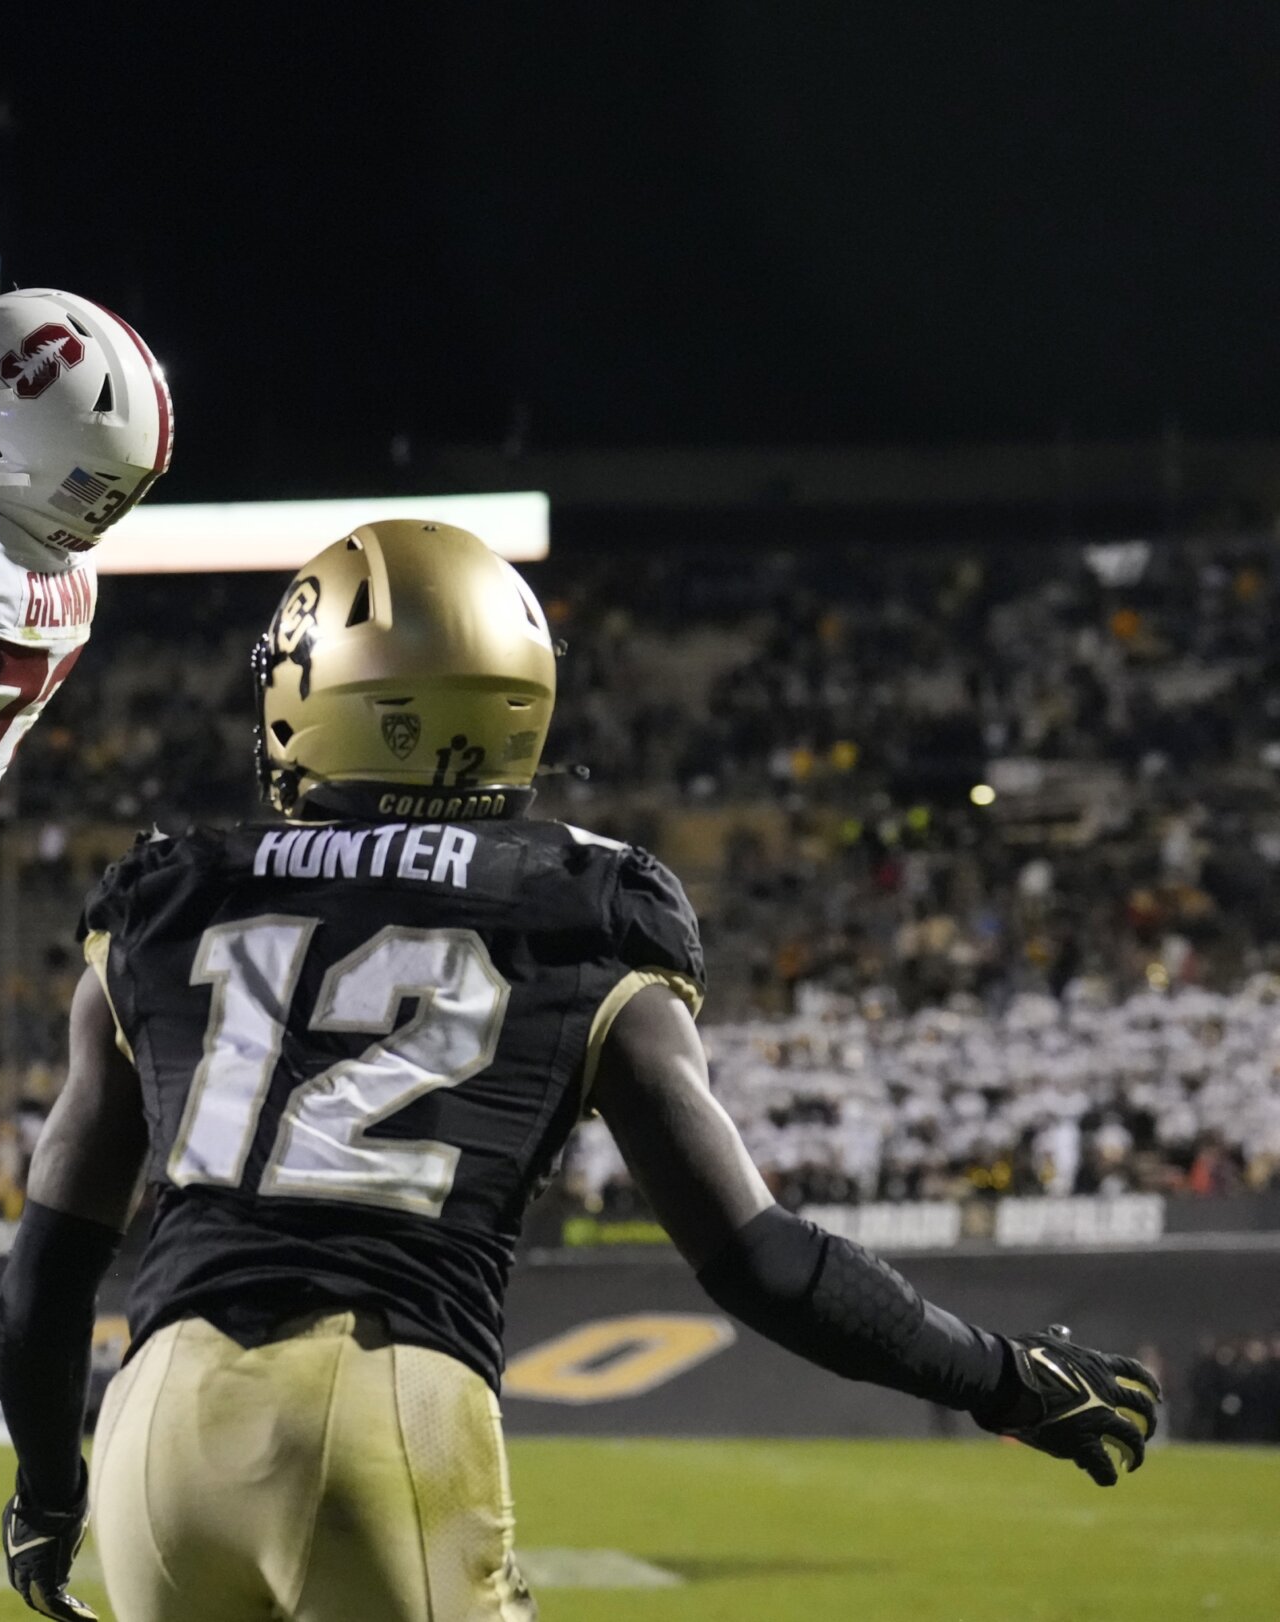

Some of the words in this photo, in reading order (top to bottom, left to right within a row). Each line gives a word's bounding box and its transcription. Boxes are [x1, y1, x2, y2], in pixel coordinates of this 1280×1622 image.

[25, 568, 91, 628] GILMAN
[432, 747, 486, 787] 12
[378, 793, 506, 818] COLORADO
[253, 823, 477, 889] HUNTER
[166, 912, 511, 1218] 12
